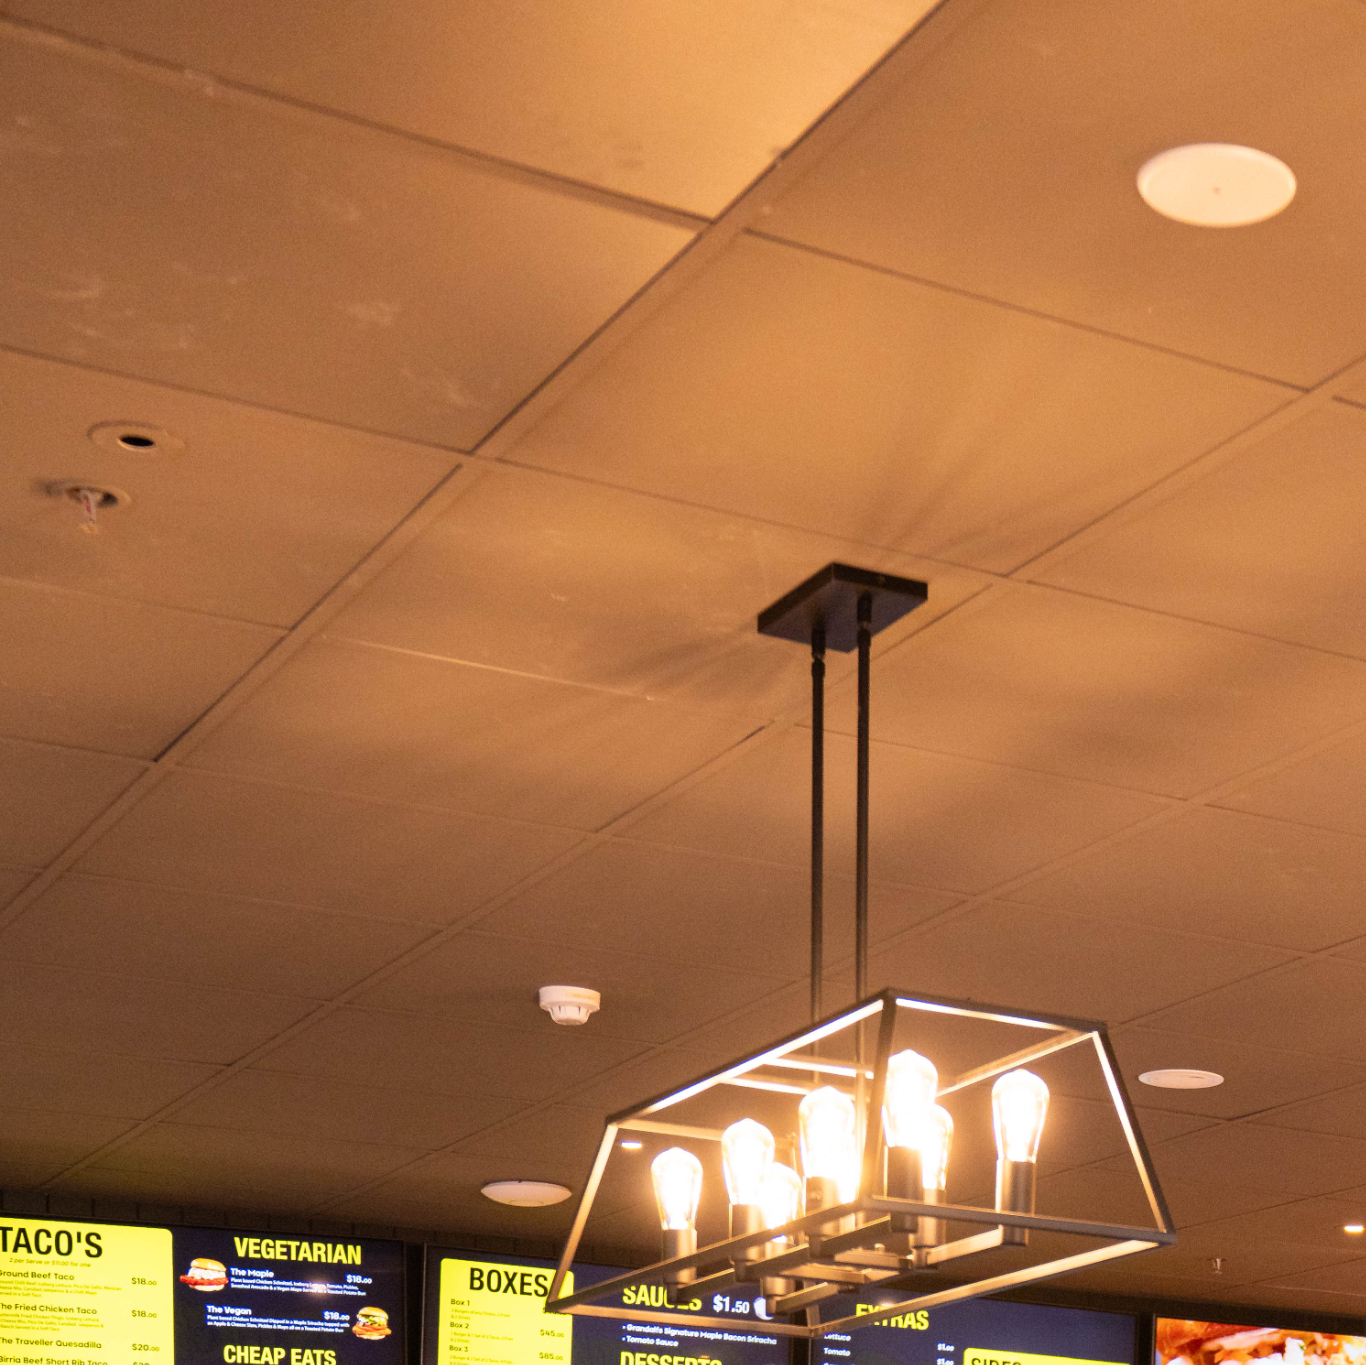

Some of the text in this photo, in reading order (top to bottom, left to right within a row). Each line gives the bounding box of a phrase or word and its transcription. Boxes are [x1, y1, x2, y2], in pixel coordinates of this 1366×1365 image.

[0, 1226, 103, 1258] TACO'S
[234, 1237, 361, 1265] VEGETARIAN
[230, 1268, 274, 1279] The Maple
[132, 1277, 157, 1286] $18.00
[346, 1274, 372, 1284] $18.00
[470, 1267, 548, 1297] BOXES
[39, 1305, 74, 1313] Chicken
[713, 1294, 750, 1314] $1.50
[132, 1310, 157, 1318] $18.00
[207, 1305, 252, 1316] The Vegan
[324, 1311, 350, 1321] $18.00
[540, 1329, 564, 1338] $45.00
[15, 1338, 102, 1348] Traveller Quesadilla
[626, 1336, 678, 1346] Tomato Sauce
[132, 1344, 160, 1352] $20.00
[824, 1347, 851, 1356] Tomato
[224, 1345, 285, 1365] CHEAP
[24, 1357, 43, 1365] Beef
[46, 1358, 69, 1365] Short
